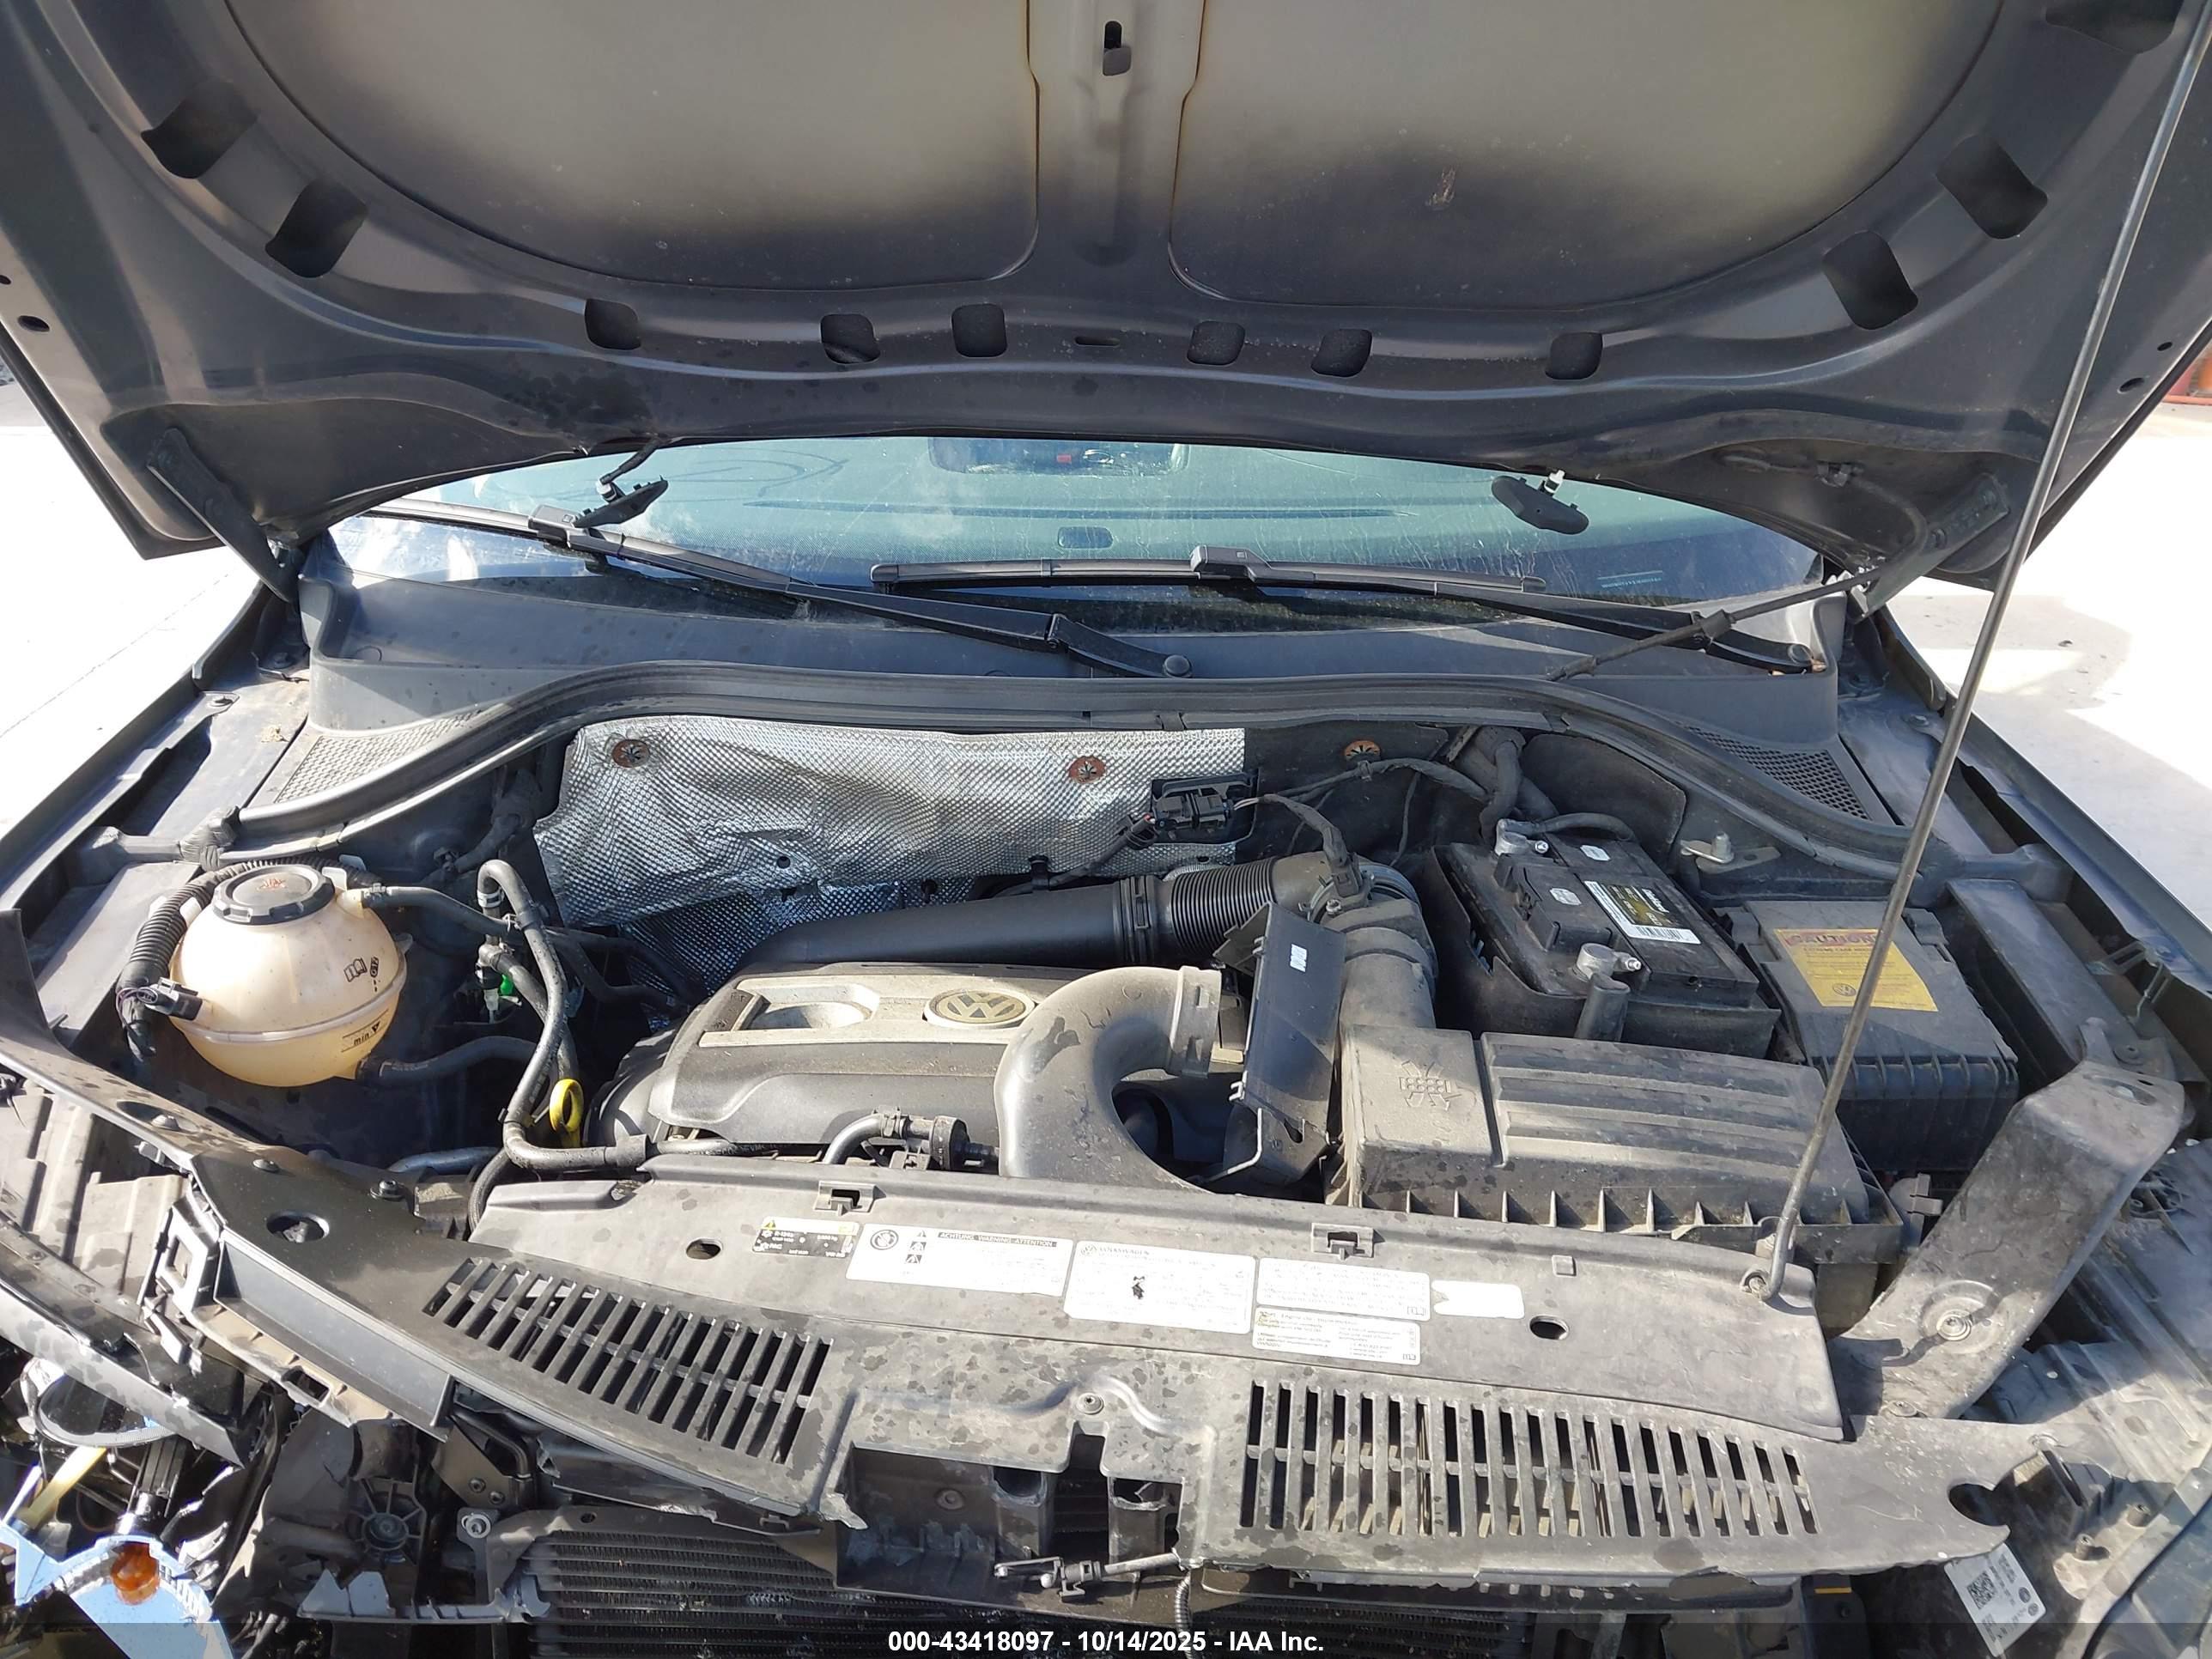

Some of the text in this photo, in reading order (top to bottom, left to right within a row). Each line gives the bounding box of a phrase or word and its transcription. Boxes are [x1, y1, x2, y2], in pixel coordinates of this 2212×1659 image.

[355, 1034, 369, 1046] min
[939, 1231, 1053, 1248] ACHTUNG WARNING ATTENTION
